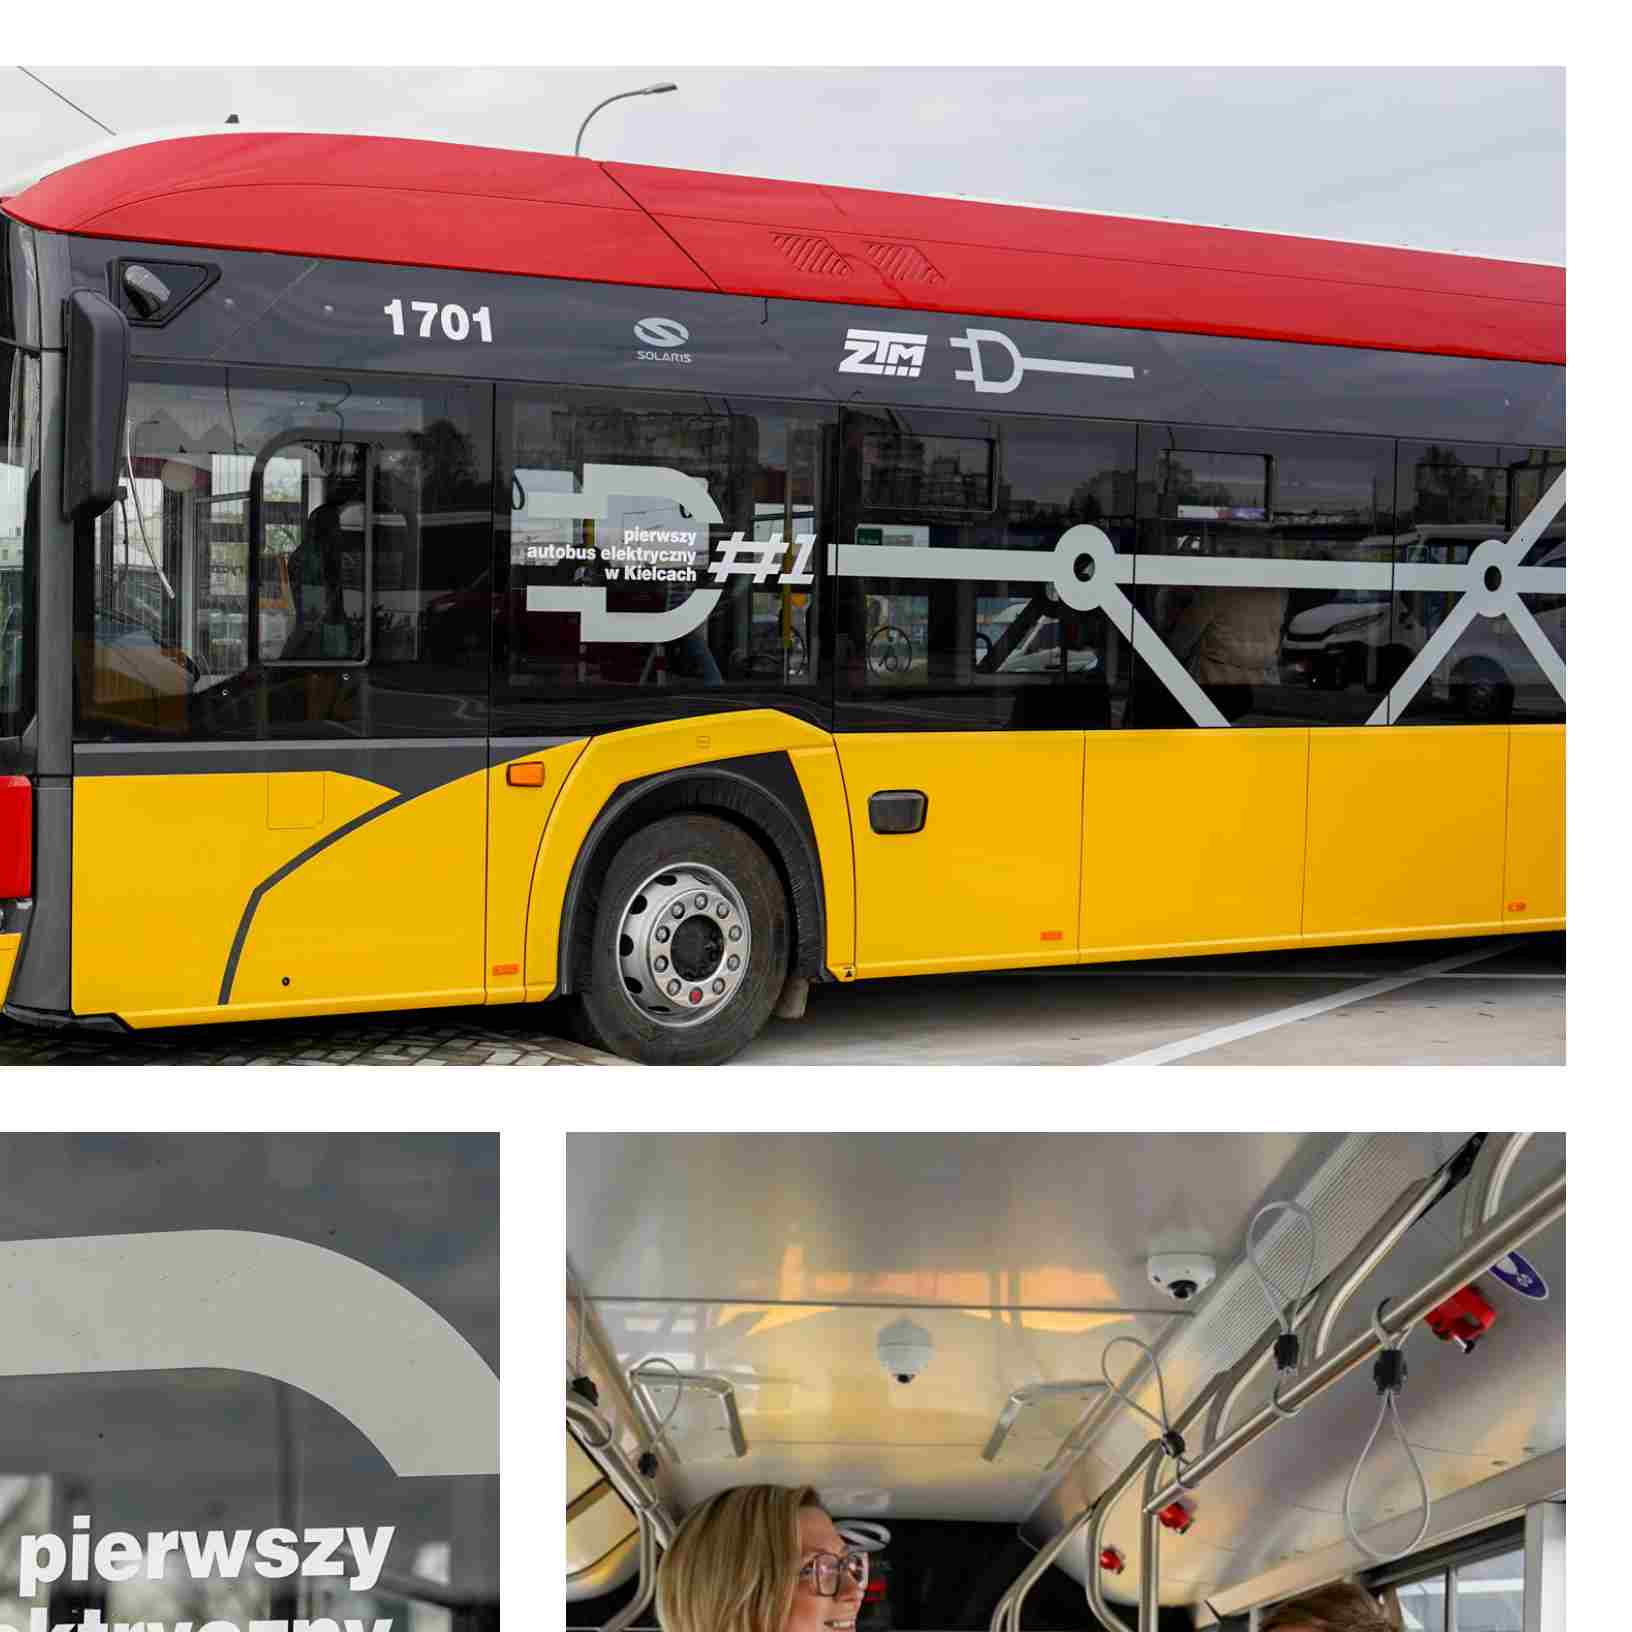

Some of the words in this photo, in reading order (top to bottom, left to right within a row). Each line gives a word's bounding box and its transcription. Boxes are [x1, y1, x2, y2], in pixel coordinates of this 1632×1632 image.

[384, 298, 493, 343] 1701
[638, 351, 693, 363] SOLARIS
[838, 328, 928, 378] ZTM
[624, 526, 697, 545] pierwszy
[527, 545, 596, 560] autobus
[601, 545, 697, 564] elektryczny
[605, 568, 619, 580] w
[624, 565, 697, 582] Kielcach
[19, 1515, 395, 1596] pierwszy
